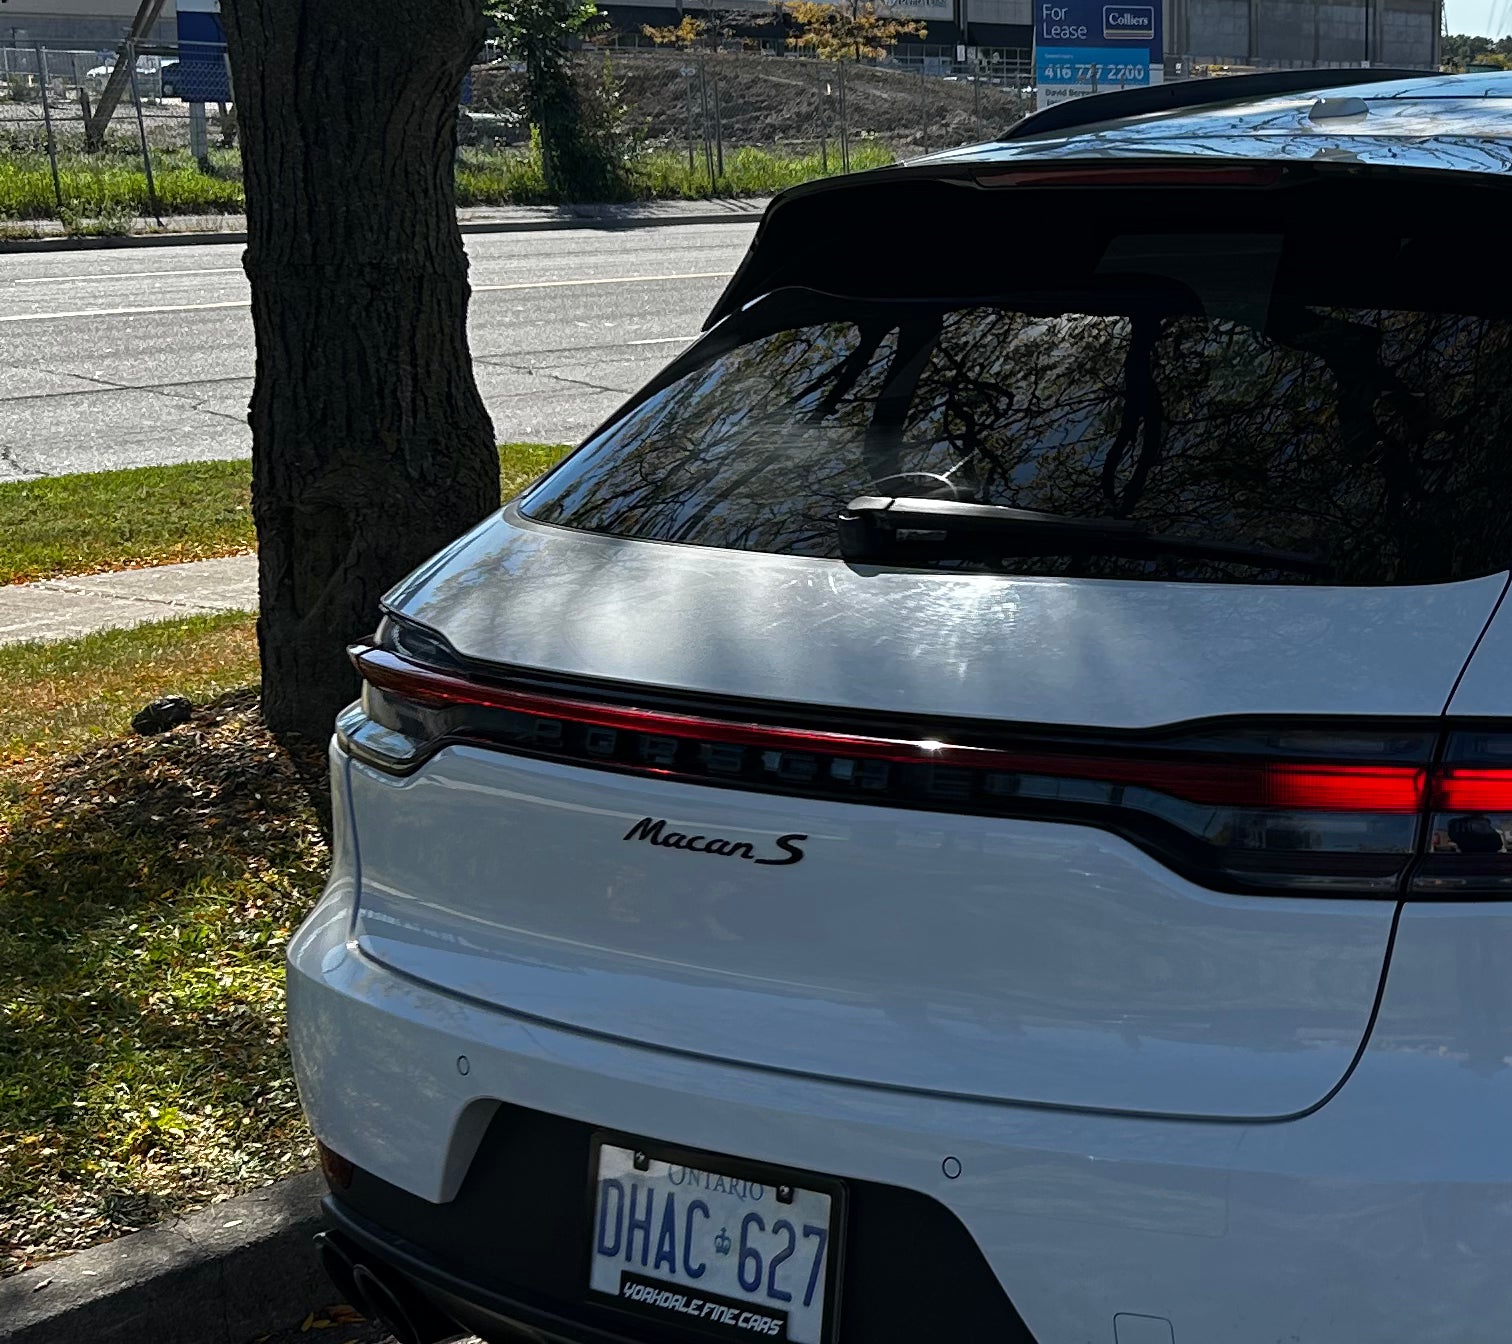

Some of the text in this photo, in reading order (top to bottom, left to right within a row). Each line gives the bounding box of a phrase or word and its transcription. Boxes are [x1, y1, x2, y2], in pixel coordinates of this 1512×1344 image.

[1042, 3, 1069, 22] For
[1108, 12, 1149, 26] Colliers
[1043, 21, 1088, 40] Lease
[1044, 64, 1072, 79] 416
[1107, 64, 1145, 80] 2200
[622, 816, 809, 867] Macan S
[597, 1178, 828, 1308] DHAC 627
[623, 1281, 784, 1337] YORKDALE FINE CARS
